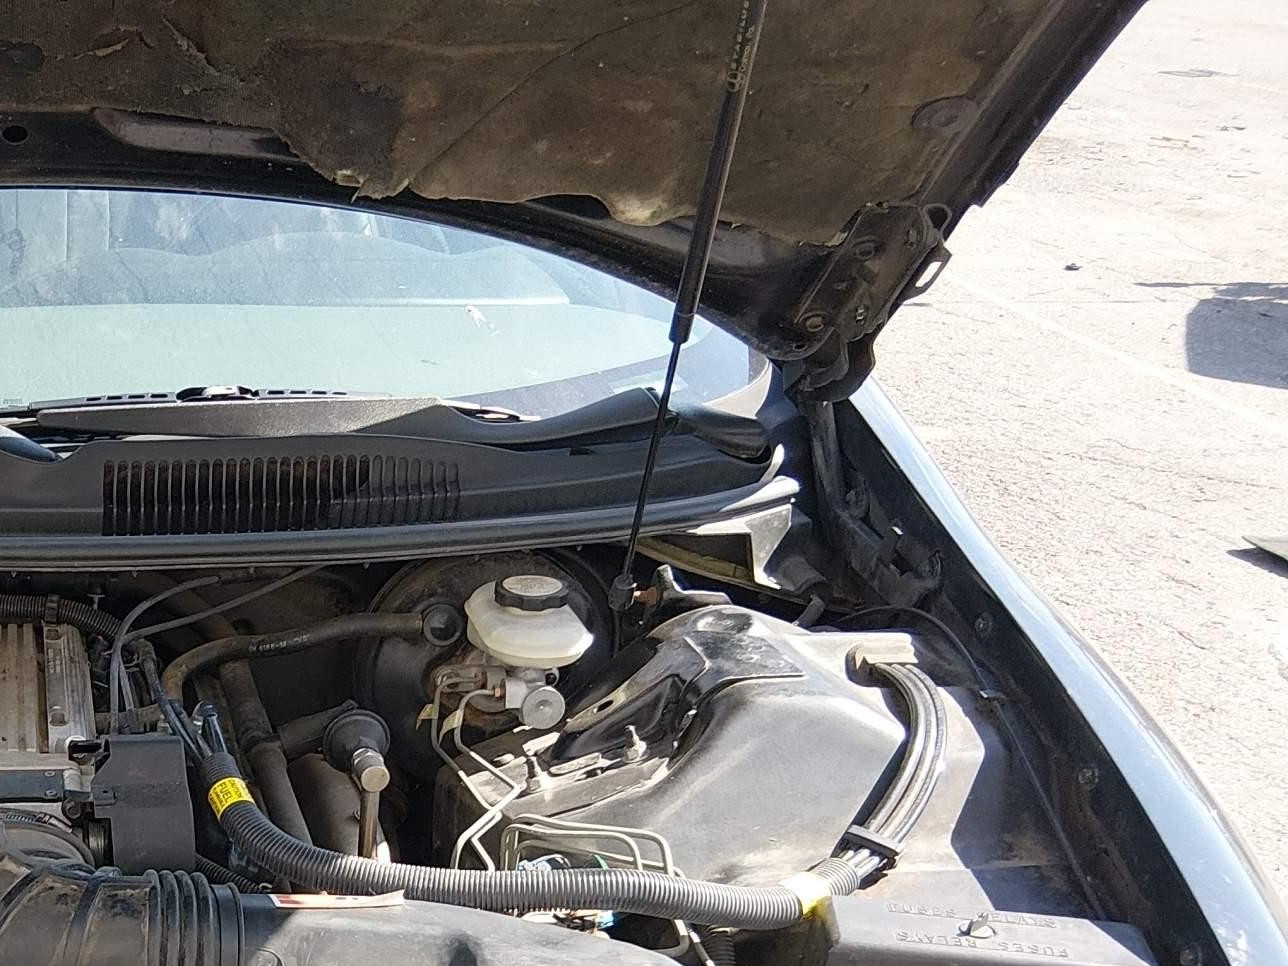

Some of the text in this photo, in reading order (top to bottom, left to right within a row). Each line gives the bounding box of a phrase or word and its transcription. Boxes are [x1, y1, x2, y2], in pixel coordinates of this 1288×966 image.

[216, 781, 233, 803] FUEL
[887, 904, 956, 918] FUSES
[896, 931, 1069, 958] FUSES RELAYS
